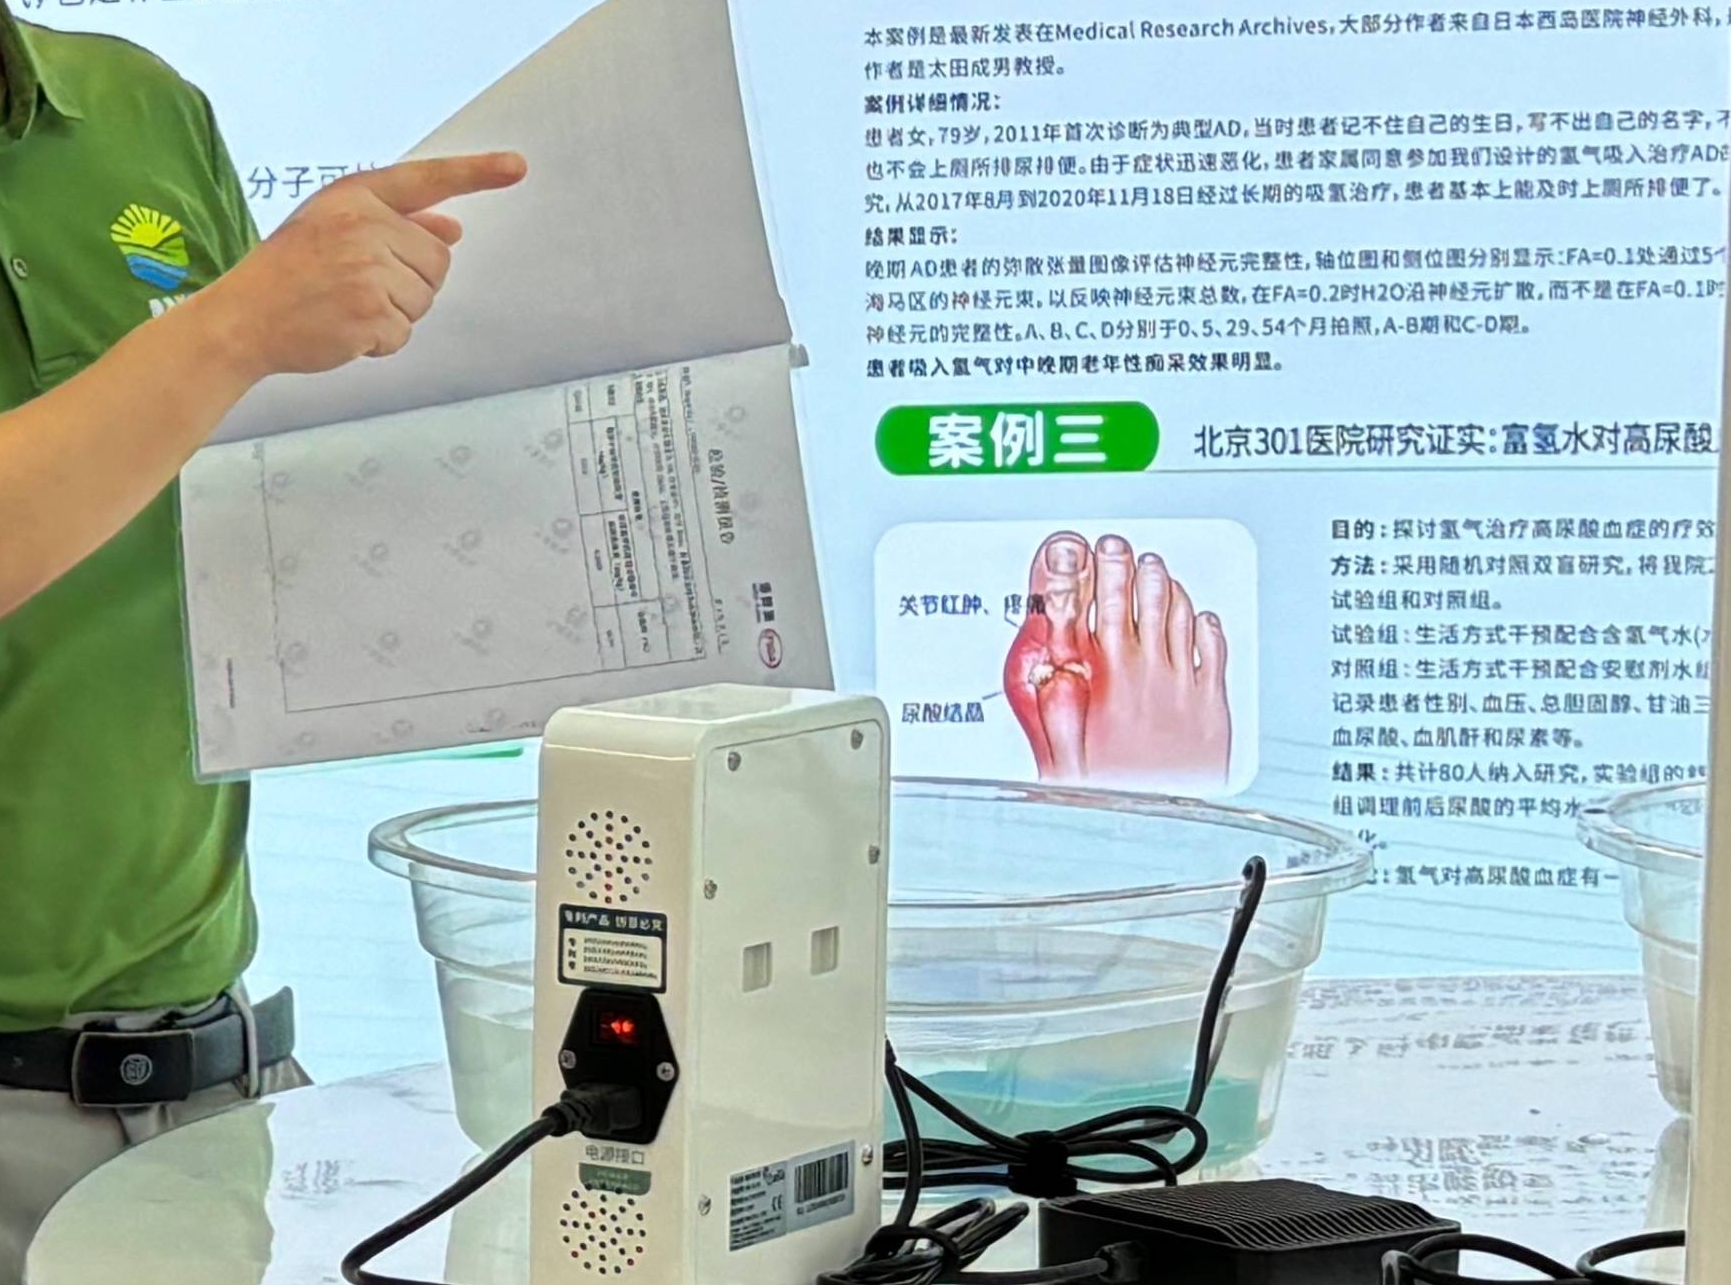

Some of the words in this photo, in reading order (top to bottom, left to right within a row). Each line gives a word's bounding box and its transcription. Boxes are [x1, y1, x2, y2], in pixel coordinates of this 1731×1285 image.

[1141, 19, 1233, 38] Research
[865, 56, 1065, 80] 作者是太田成男教授。
[928, 411, 1107, 468] 案例三
[1331, 589, 1502, 611] 试验组和对照组。
